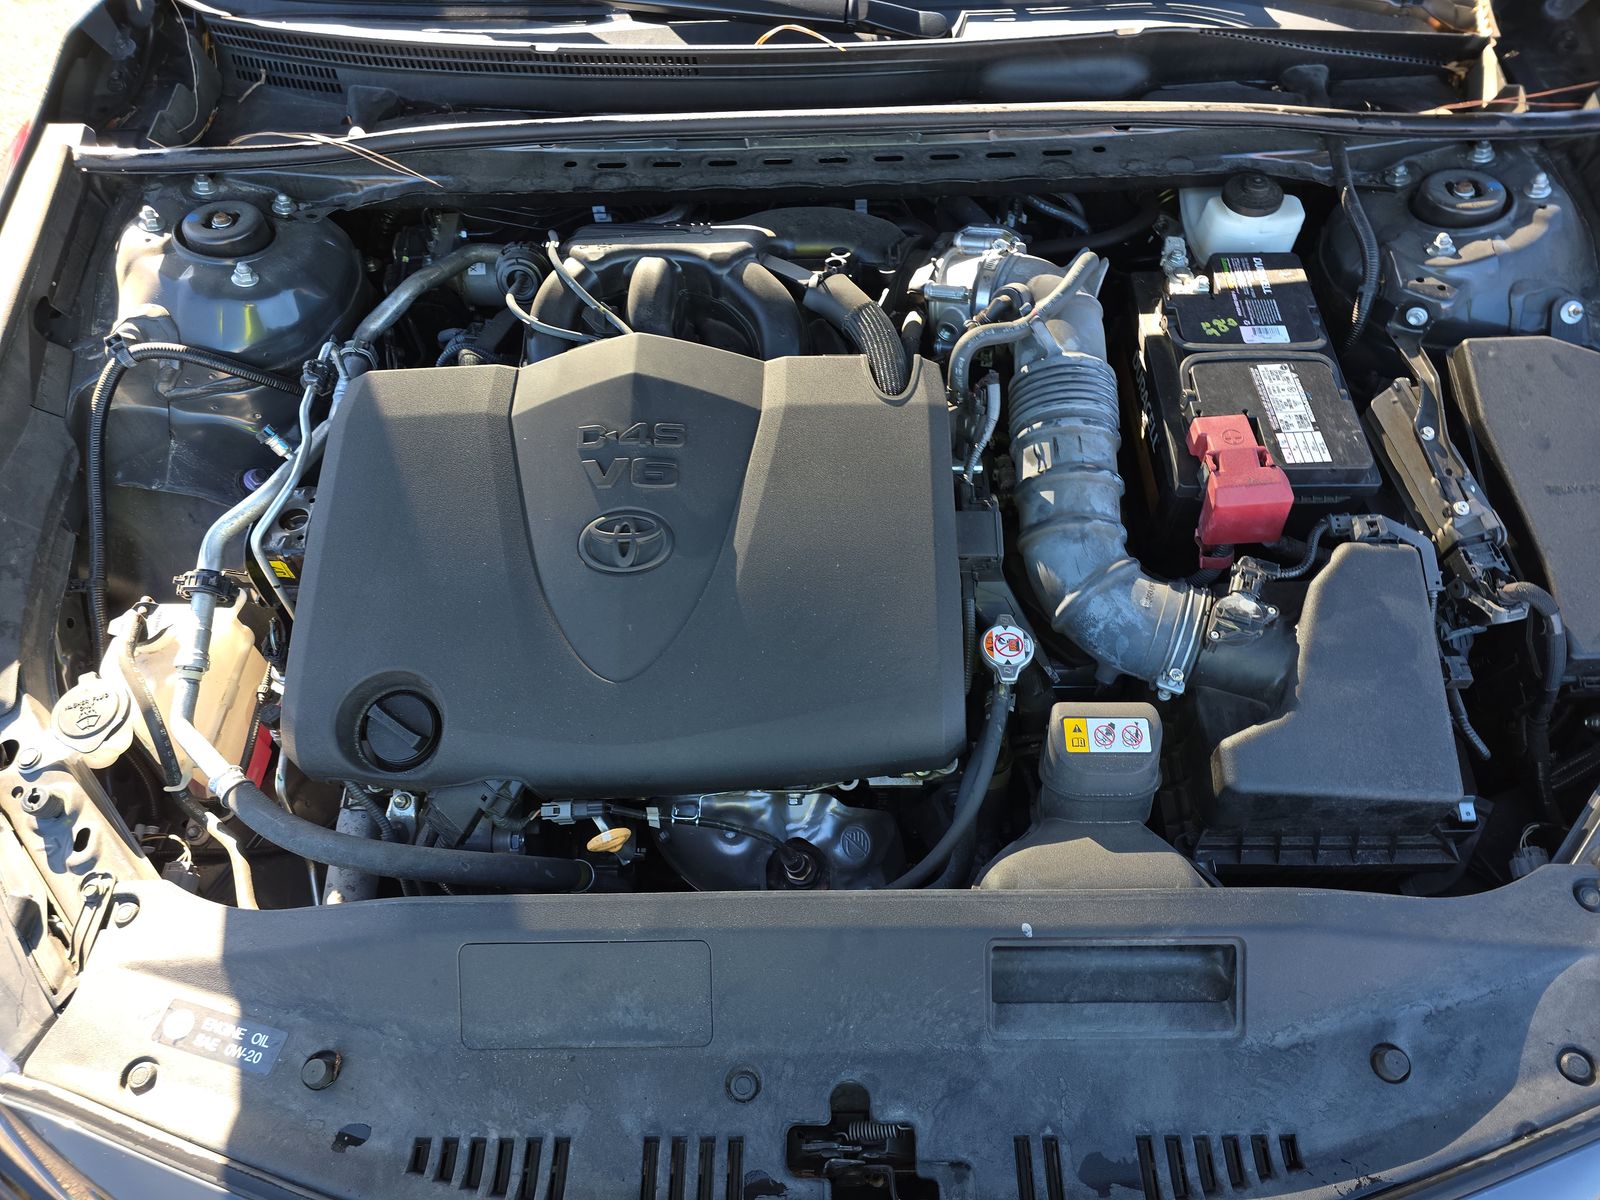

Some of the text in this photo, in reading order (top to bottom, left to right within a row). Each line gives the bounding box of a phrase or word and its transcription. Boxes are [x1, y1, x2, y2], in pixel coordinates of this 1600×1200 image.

[1252, 257, 1273, 295] DUELL
[581, 457, 679, 489] V6
[250, 1032, 270, 1048] OIL
[223, 1043, 262, 1064] 0W-20
